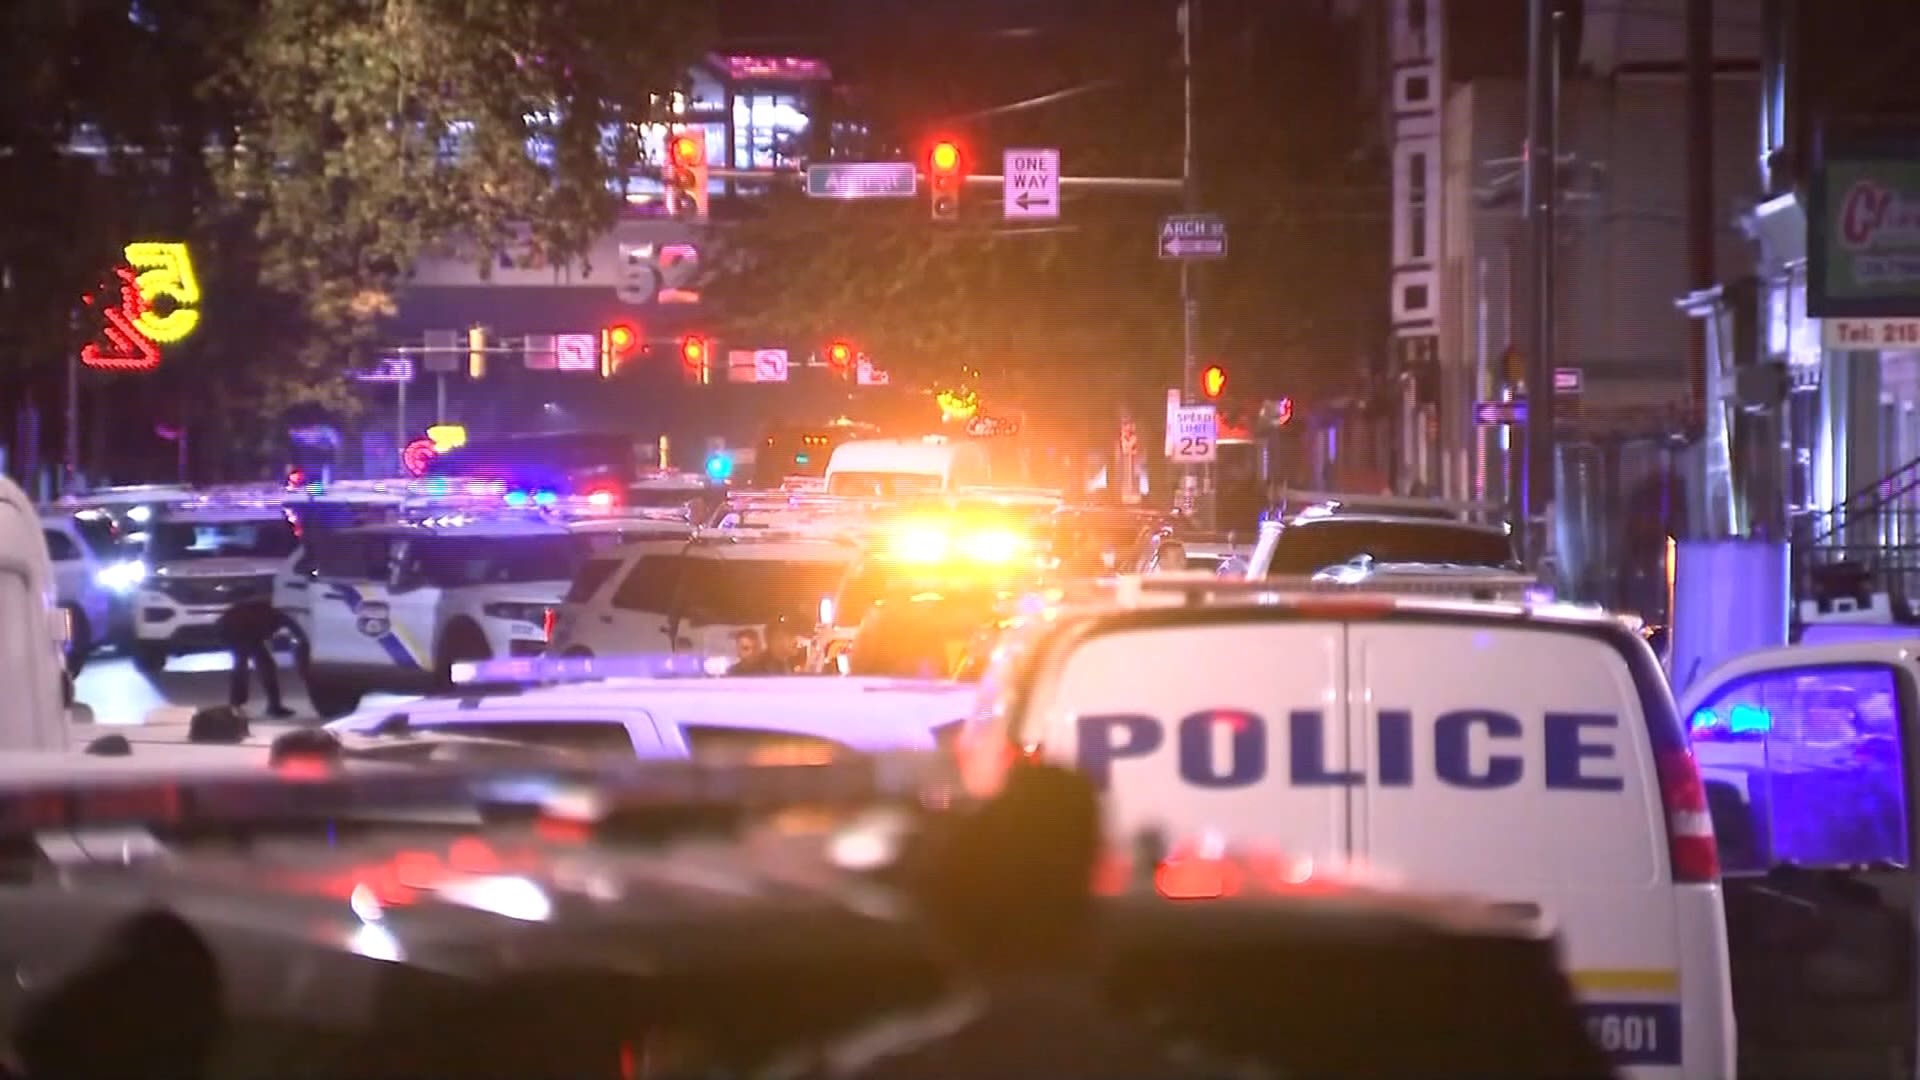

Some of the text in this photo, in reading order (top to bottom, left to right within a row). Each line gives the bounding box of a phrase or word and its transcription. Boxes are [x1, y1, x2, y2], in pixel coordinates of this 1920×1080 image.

[1015, 158, 1048, 170] ONE
[1014, 175, 1048, 188] WAY
[1163, 221, 1205, 236] ARCH
[617, 241, 699, 304] 52
[1177, 413, 1211, 422] SPEED
[1180, 423, 1206, 433] LIMIT
[1180, 436, 1209, 456] 25
[1076, 709, 1624, 792] POLICE
